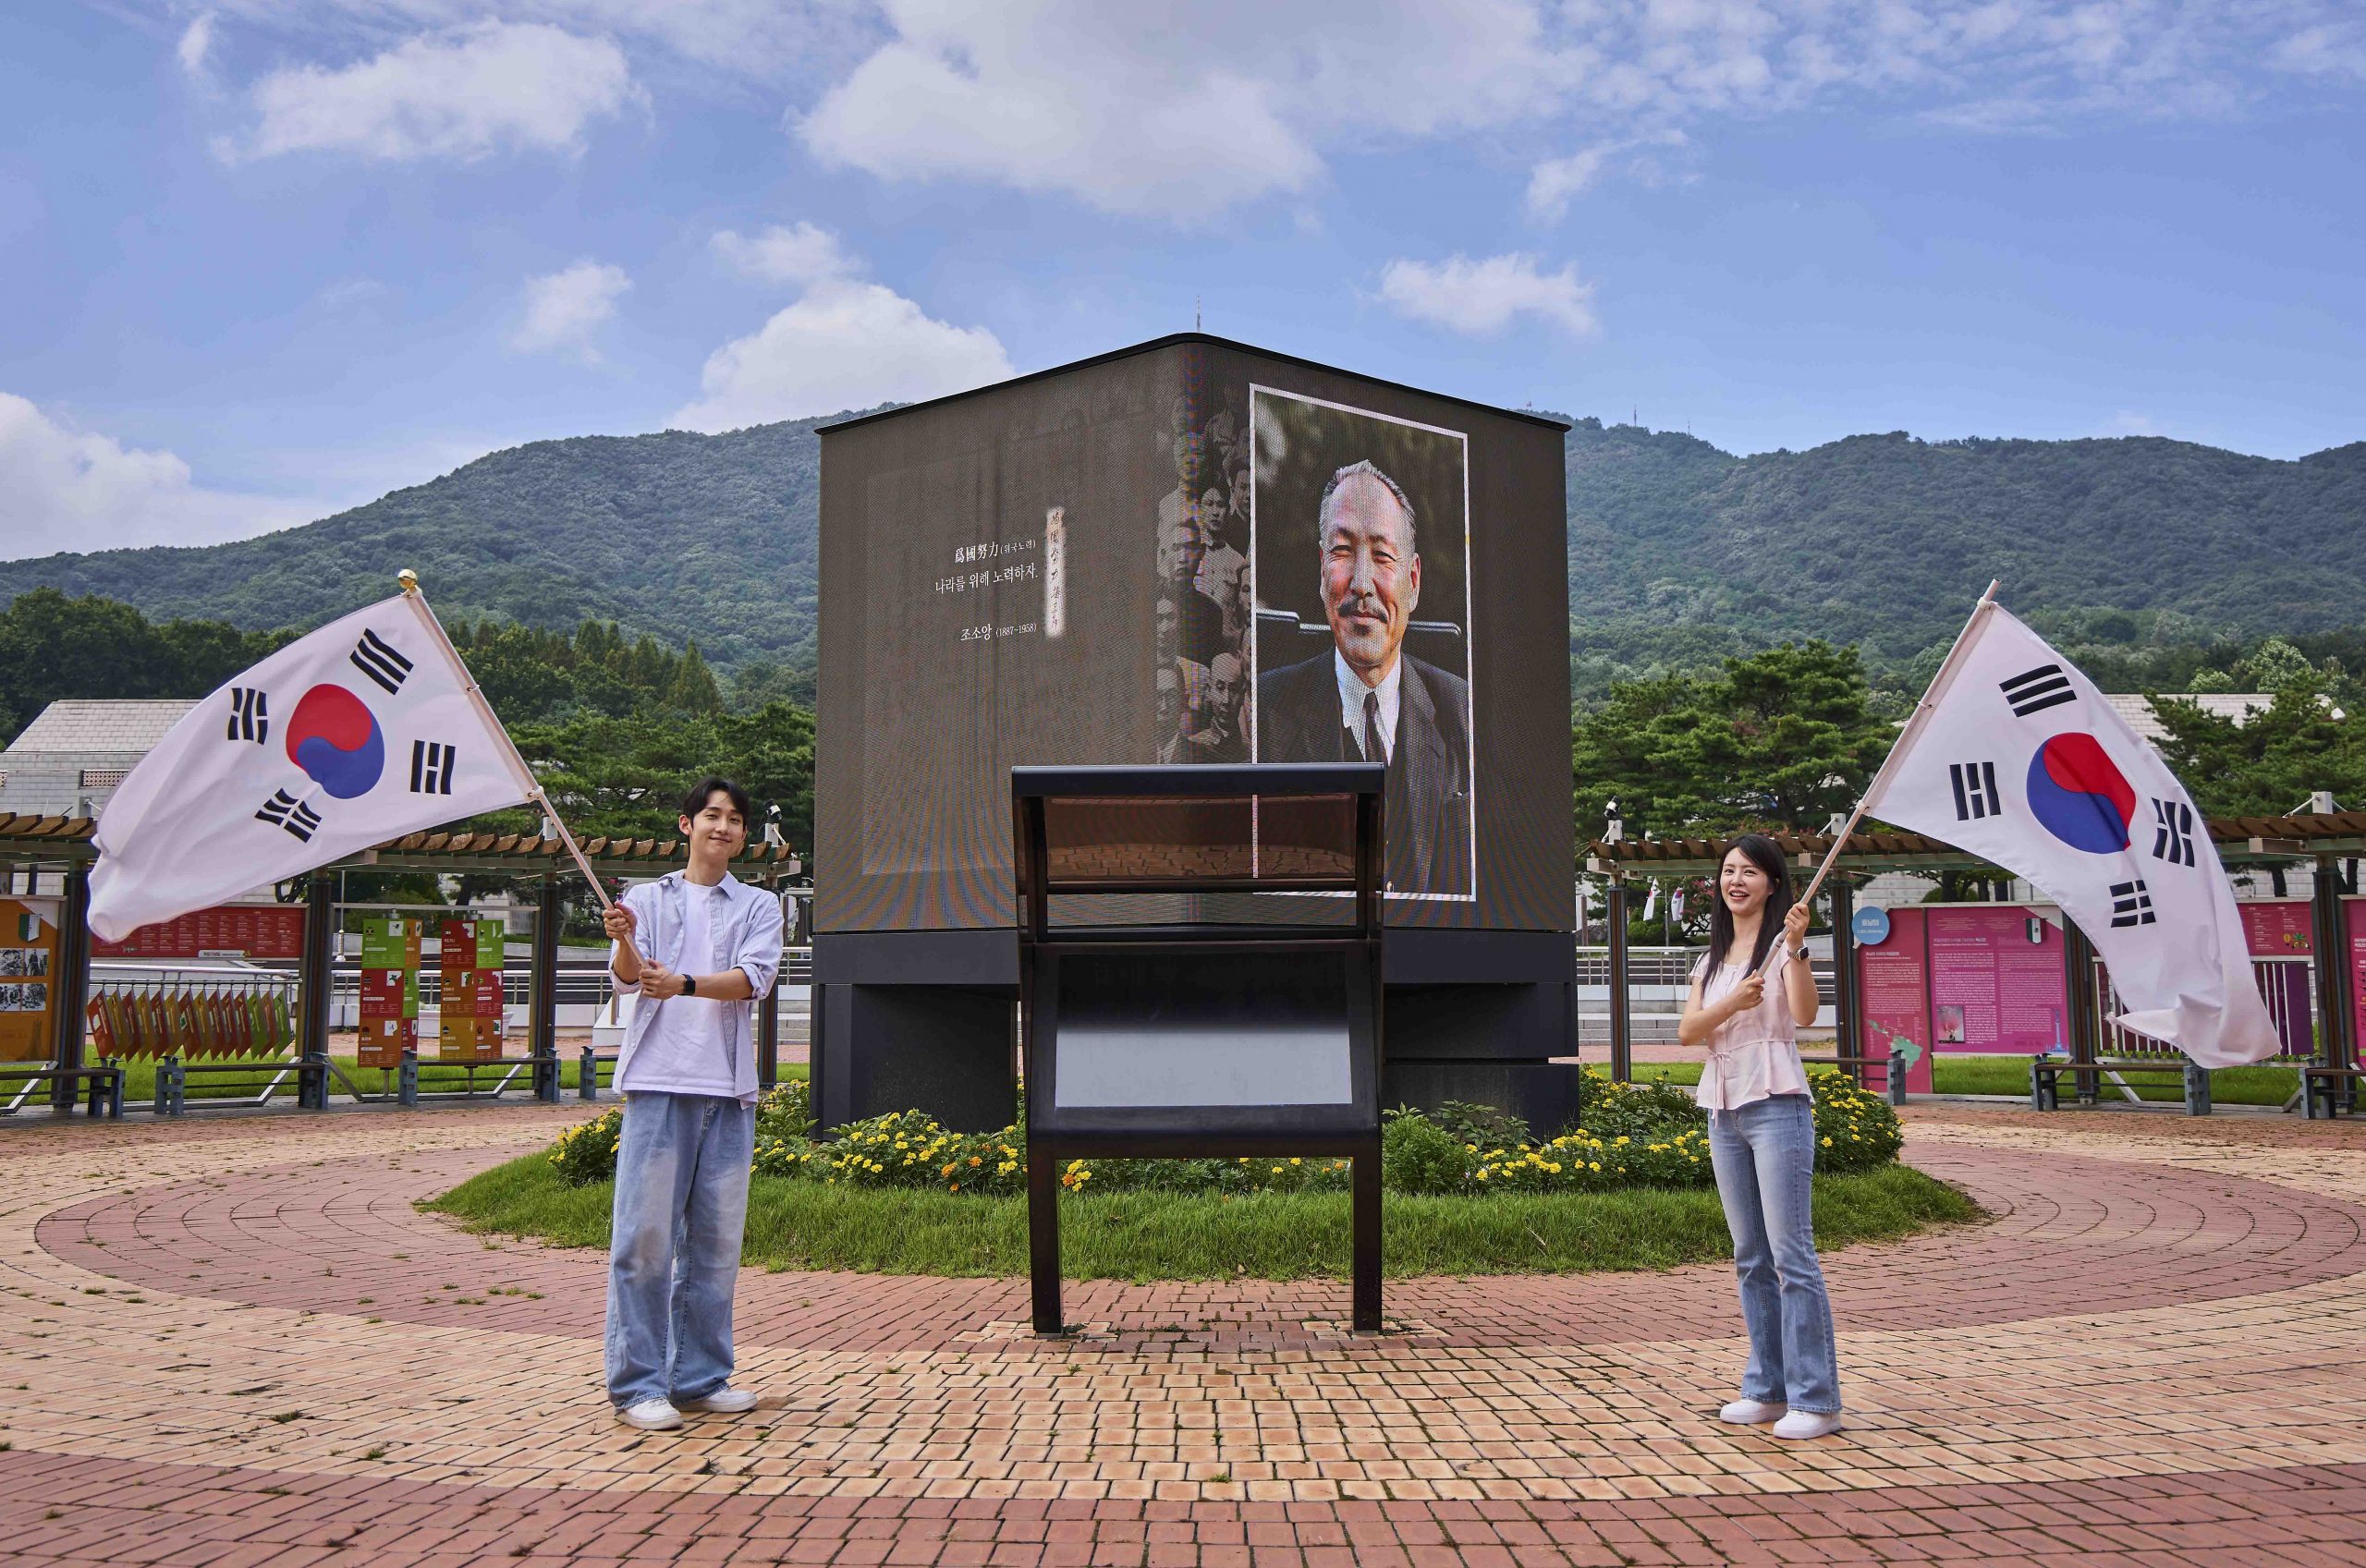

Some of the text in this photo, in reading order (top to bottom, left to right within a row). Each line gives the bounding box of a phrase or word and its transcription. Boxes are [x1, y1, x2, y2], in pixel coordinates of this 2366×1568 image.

[935, 562, 1039, 594] 나라를 위해 노력하자.
[960, 624, 993, 642] 조소앙
